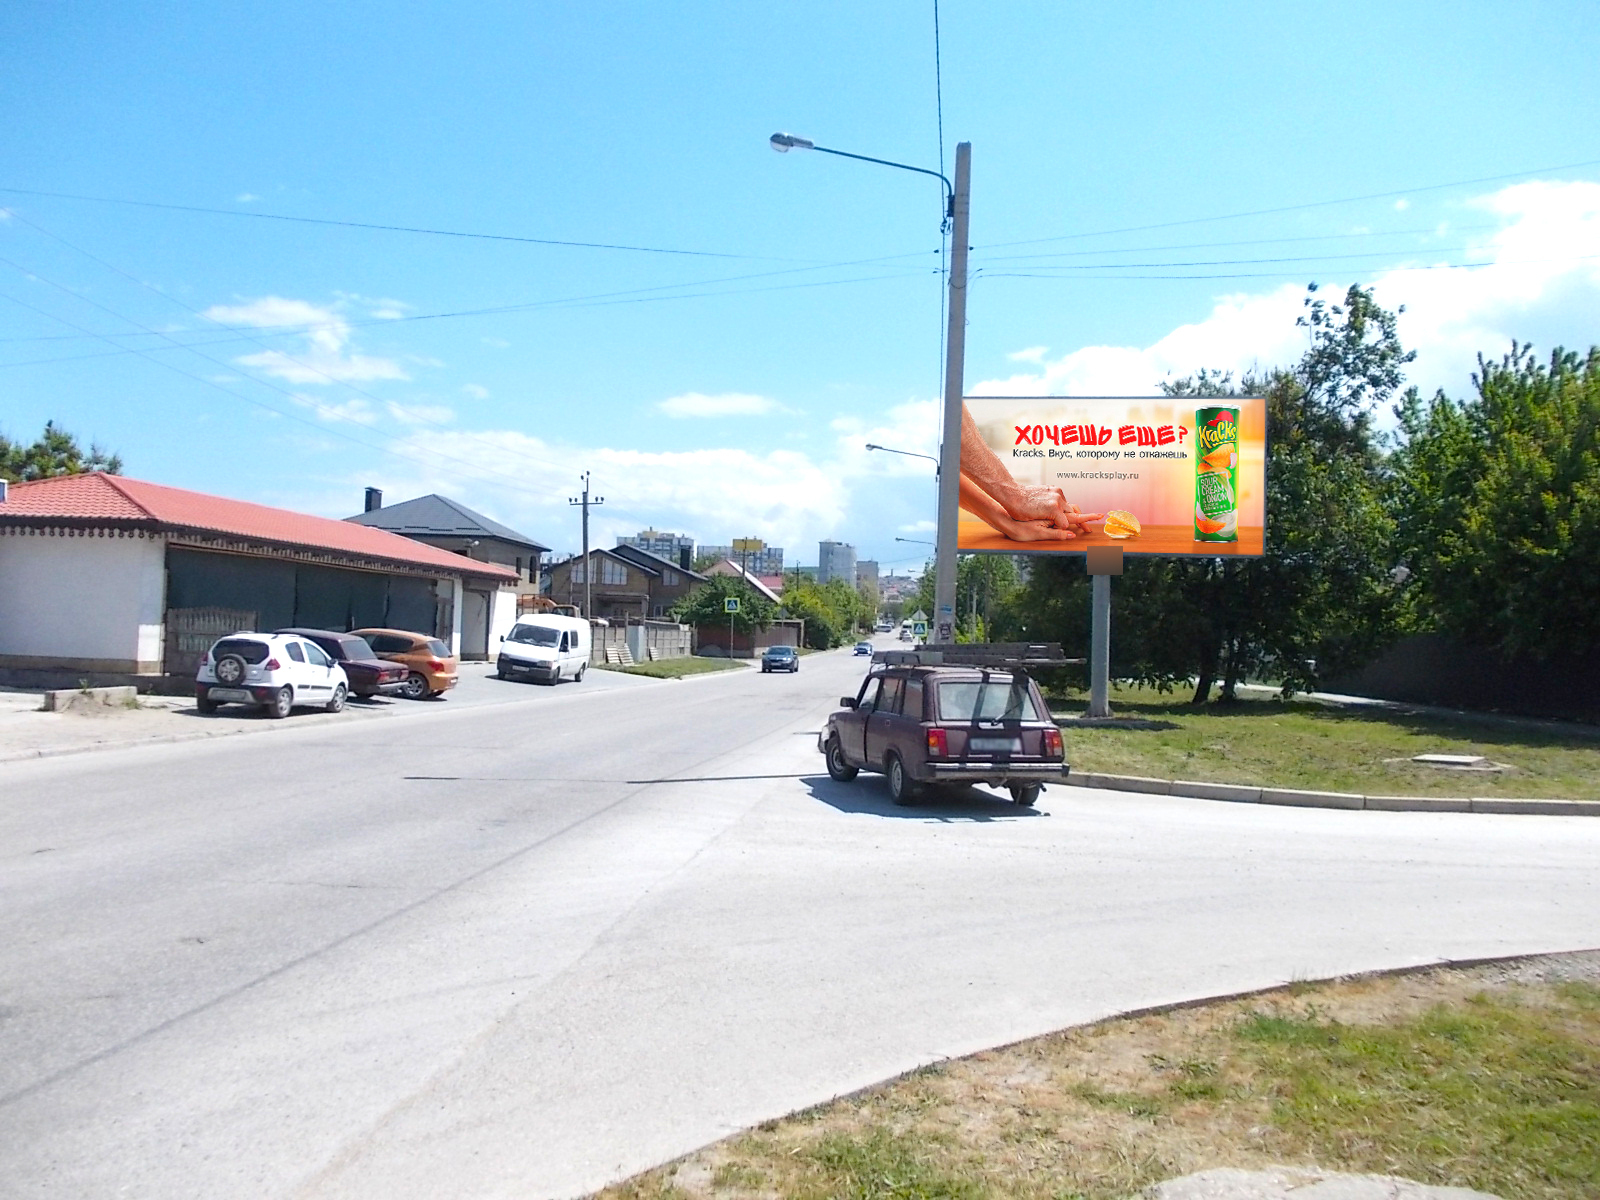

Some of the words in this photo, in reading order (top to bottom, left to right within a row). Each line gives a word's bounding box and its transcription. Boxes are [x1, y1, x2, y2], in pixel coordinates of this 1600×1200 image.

[1014, 424, 1112, 446] ХОЧЕШЬ
[1118, 425, 1188, 447] ЕЩЕ?
[1012, 448, 1046, 457] Kracks.
[1048, 448, 1073, 460] Вкус,
[1076, 450, 1120, 460] которому
[1139, 450, 1188, 459] откажешь
[1056, 470, 1139, 480] www.kracksplay.ru
